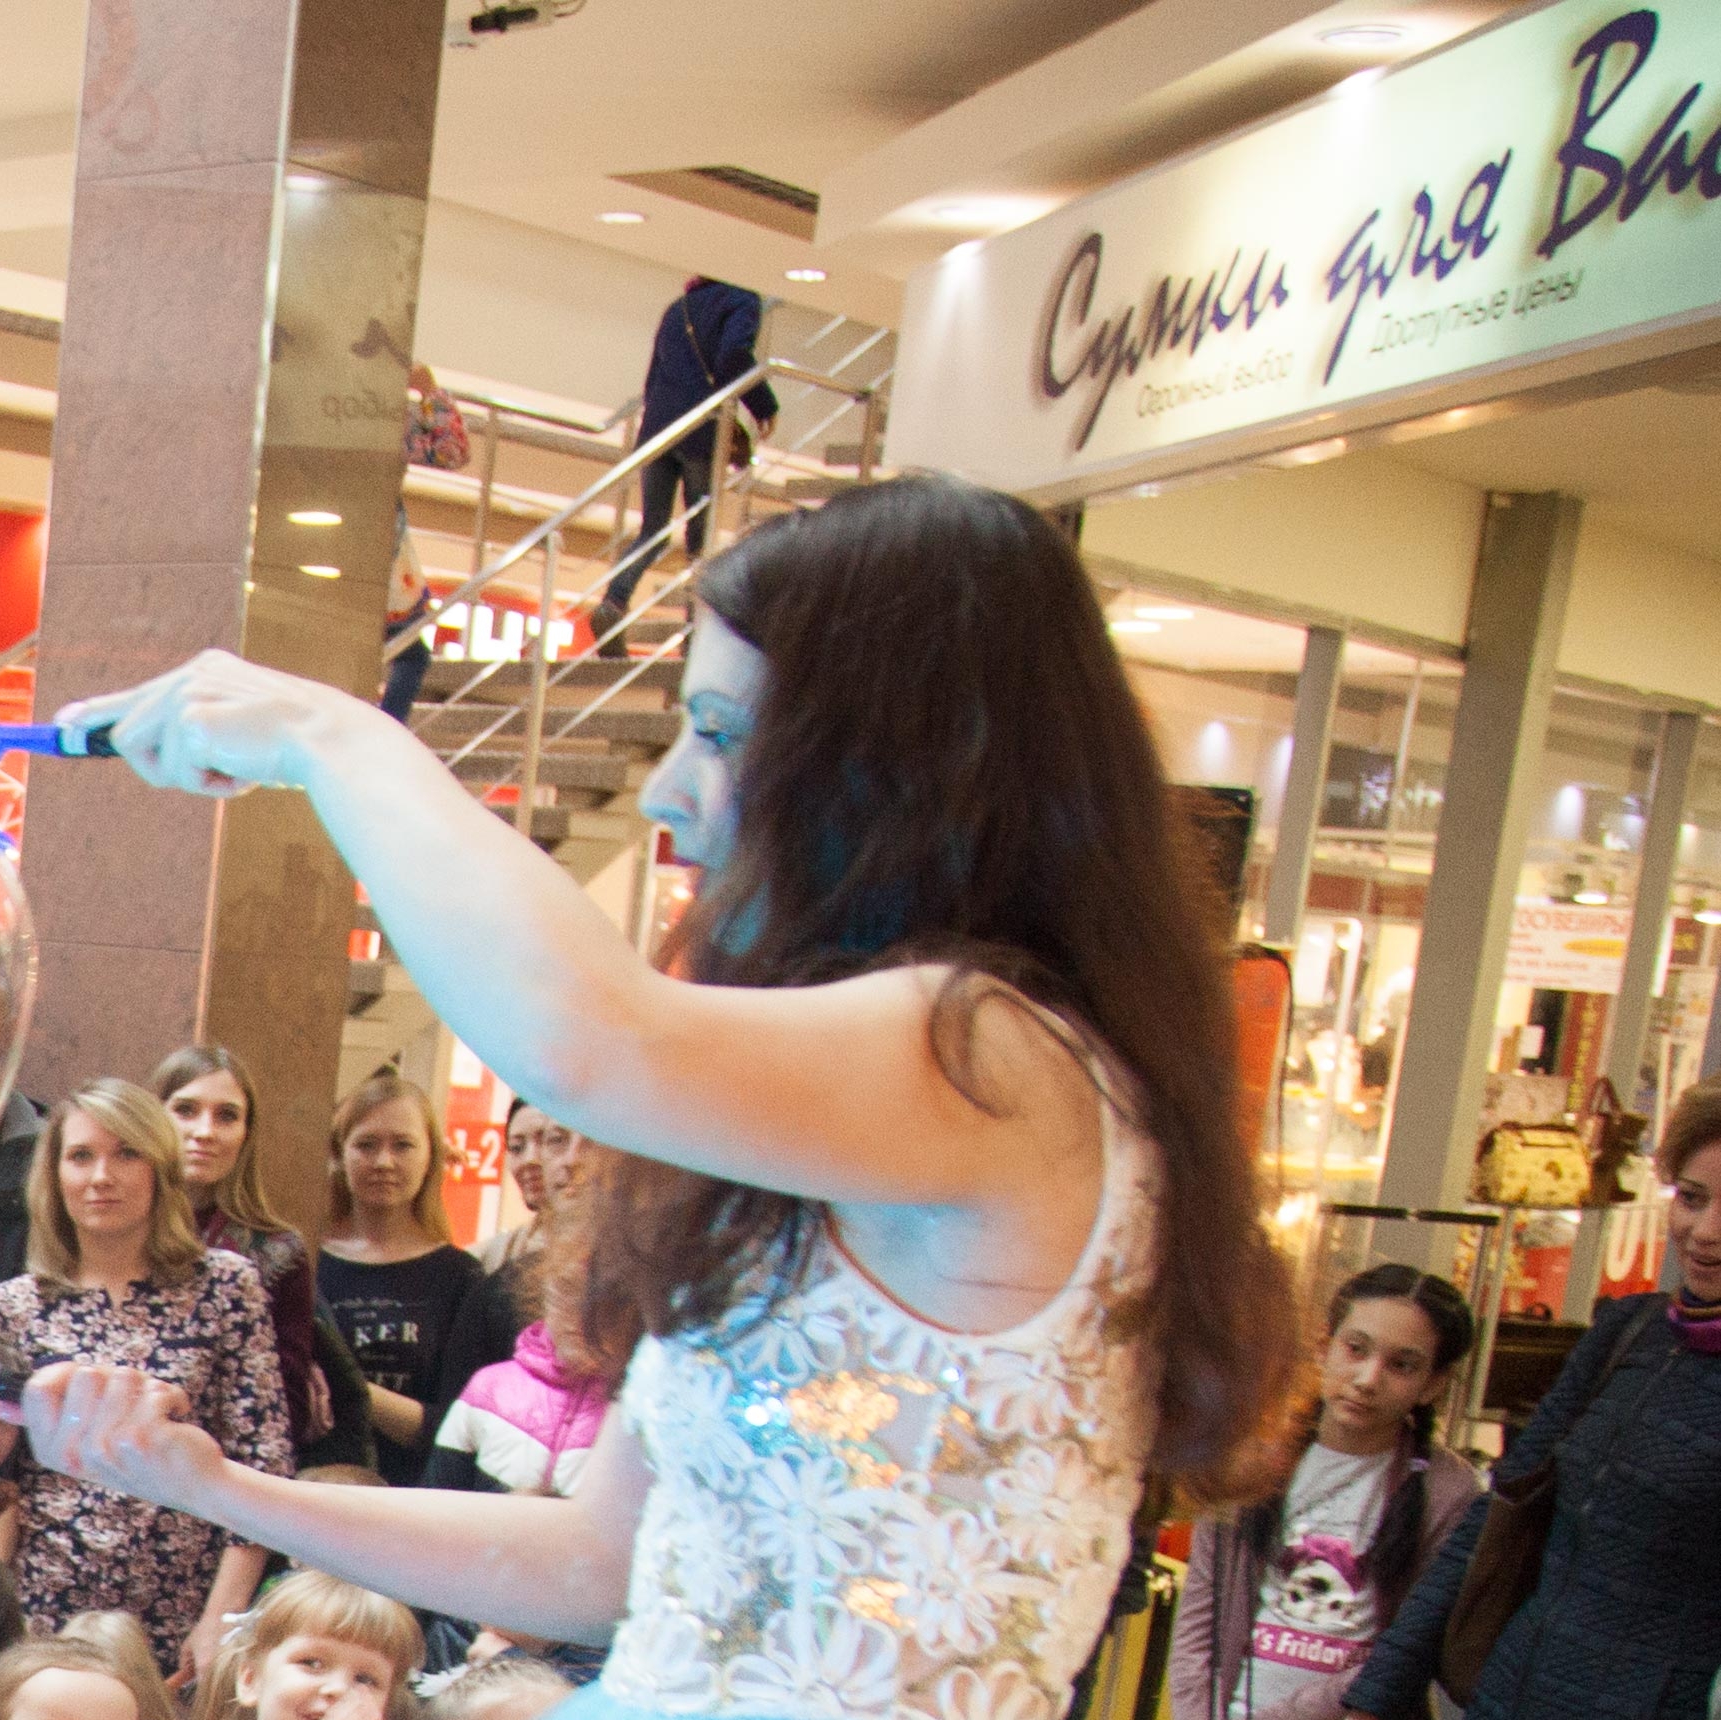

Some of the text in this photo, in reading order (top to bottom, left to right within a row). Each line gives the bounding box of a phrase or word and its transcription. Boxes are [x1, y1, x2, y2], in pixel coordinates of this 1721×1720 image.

[1040, 229, 1290, 453] Сумки
[1323, 147, 1514, 387] для
[1367, 266, 1587, 361] Доступные цены
